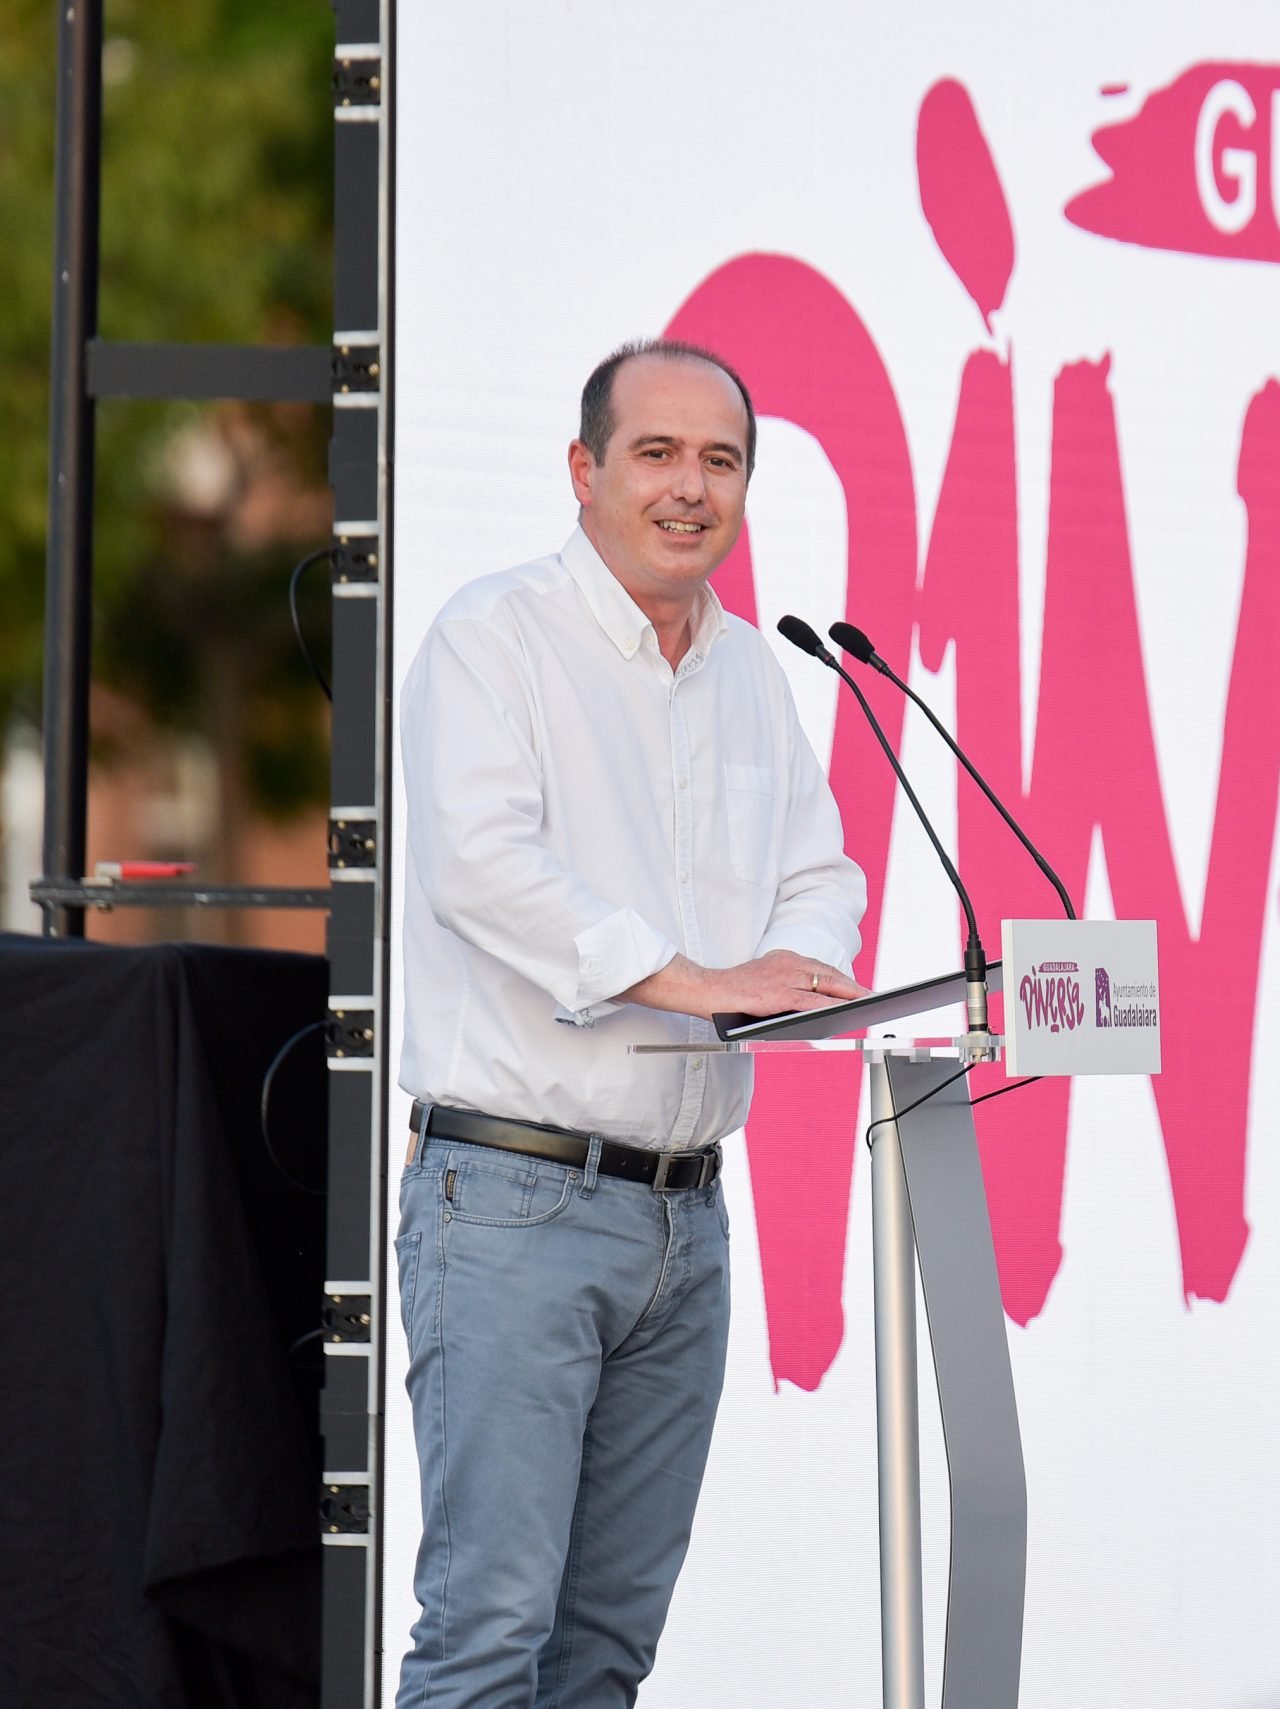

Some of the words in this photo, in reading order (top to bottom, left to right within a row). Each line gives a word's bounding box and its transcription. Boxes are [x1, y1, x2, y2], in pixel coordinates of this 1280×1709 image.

[1042, 963, 1075, 972] GUADALAJARA
[1113, 981, 1148, 1001] Ayuntamiento
[1148, 982, 1157, 998] de
